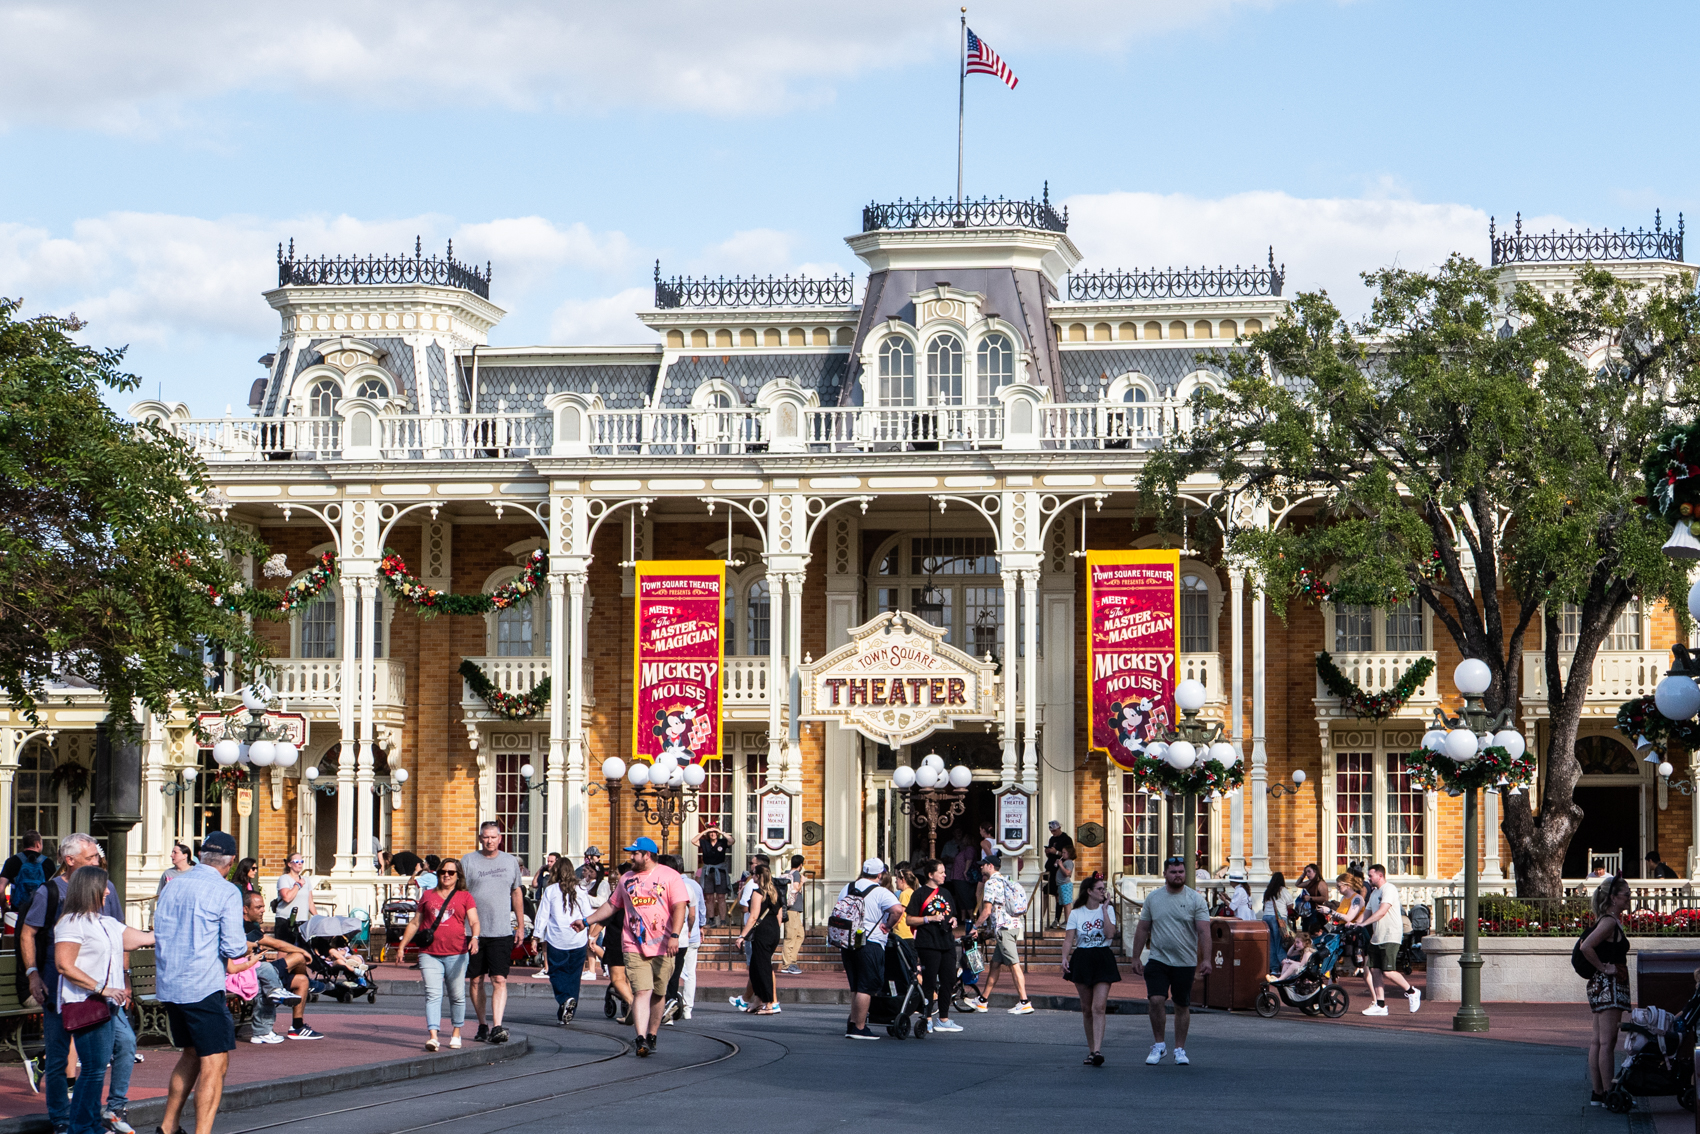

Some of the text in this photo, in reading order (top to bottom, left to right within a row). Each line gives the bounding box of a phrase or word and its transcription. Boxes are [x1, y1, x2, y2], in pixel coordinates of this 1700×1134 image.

[1093, 569, 1173, 583] TOWN SQUARE THEATER
[641, 580, 719, 593] TOWN SQUARE THEATER
[649, 605, 675, 615] MEET
[1101, 595, 1128, 606] MEET
[656, 616, 670, 627] The
[1103, 610, 1151, 631] MASTER
[1109, 606, 1124, 618] The
[650, 620, 697, 641] MASTER
[655, 627, 718, 653] MAGICIAN
[1108, 617, 1173, 644] MAGICIAN
[858, 645, 937, 669] TOWN SQUARE
[640, 662, 718, 690] MICKEY
[1094, 653, 1174, 682] MICKEY
[651, 684, 706, 703] MOUSE
[826, 678, 967, 705] THEATER
[1106, 675, 1163, 694] MOUSE
[1012, 830, 1022, 838] 25
